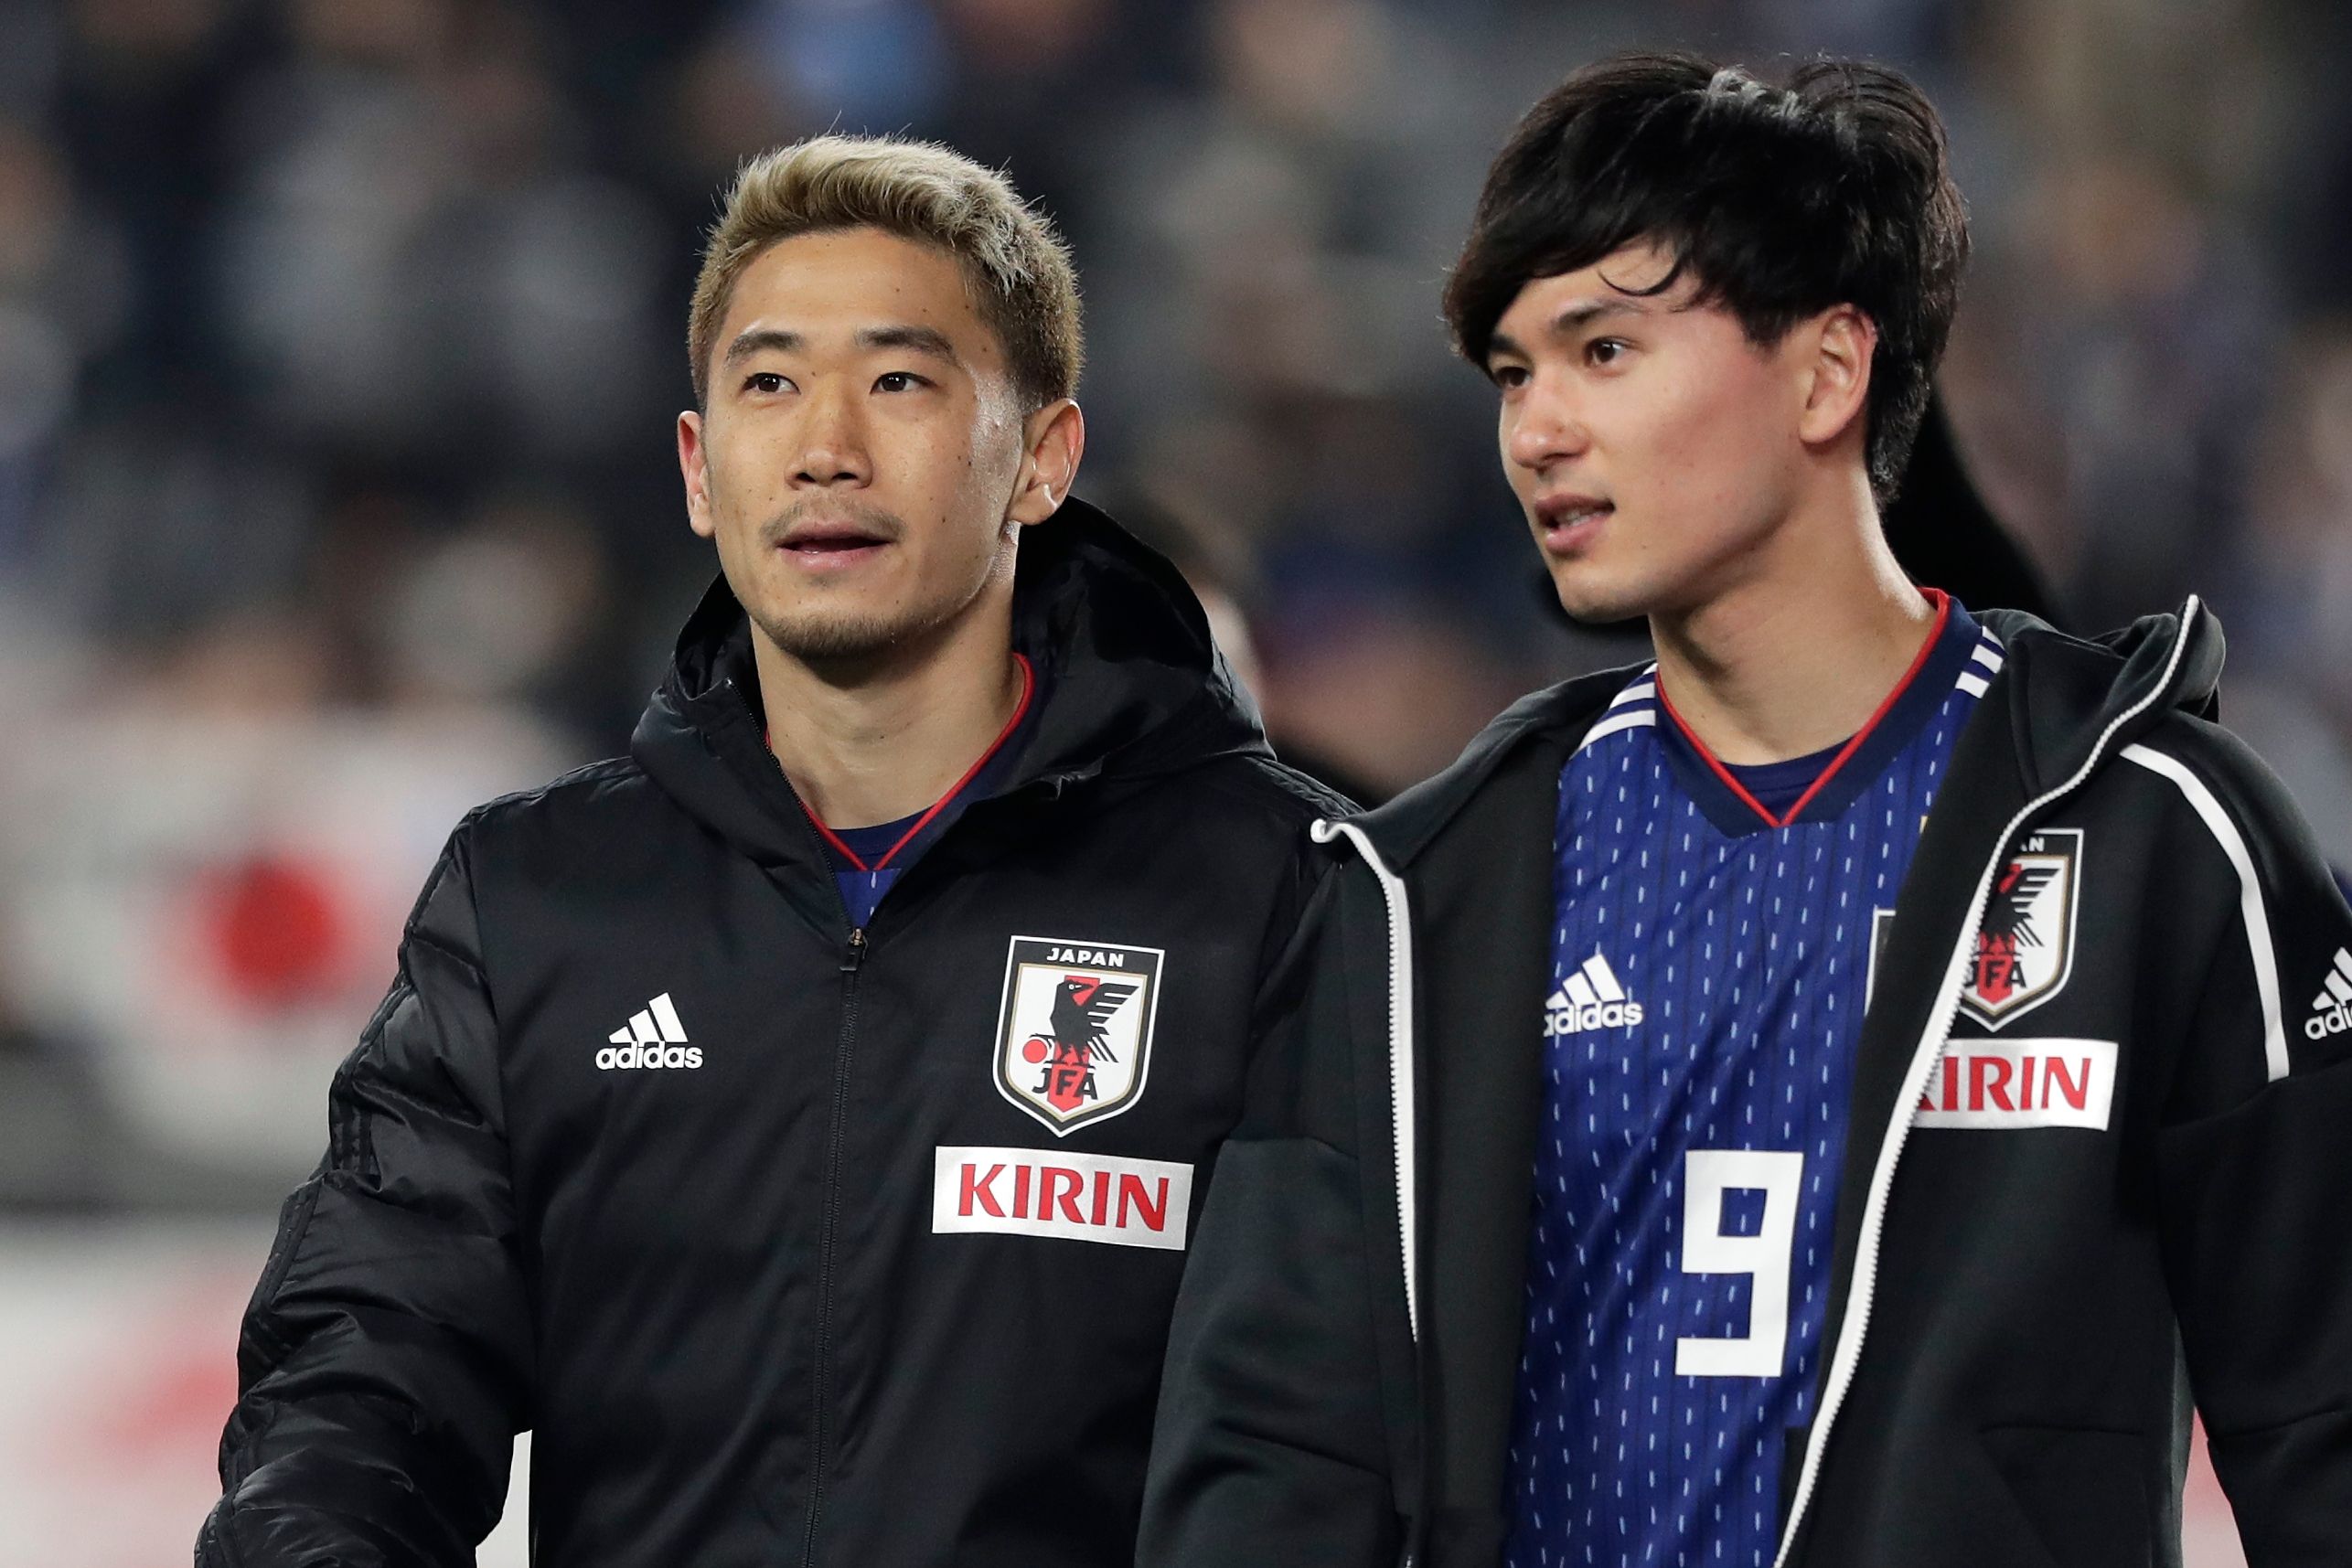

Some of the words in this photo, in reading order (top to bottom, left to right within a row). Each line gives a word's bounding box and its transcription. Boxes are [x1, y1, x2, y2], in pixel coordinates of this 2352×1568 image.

[1047, 947, 1124, 967] JAPAN
[2304, 1002, 2352, 1040] adi
[595, 1040, 703, 1070] adidas
[1032, 1067, 1098, 1100] JFA
[1919, 1056, 2092, 1112] IRIN
[957, 1163, 1170, 1232] KIRIN
[1675, 1149, 1803, 1377] 9
